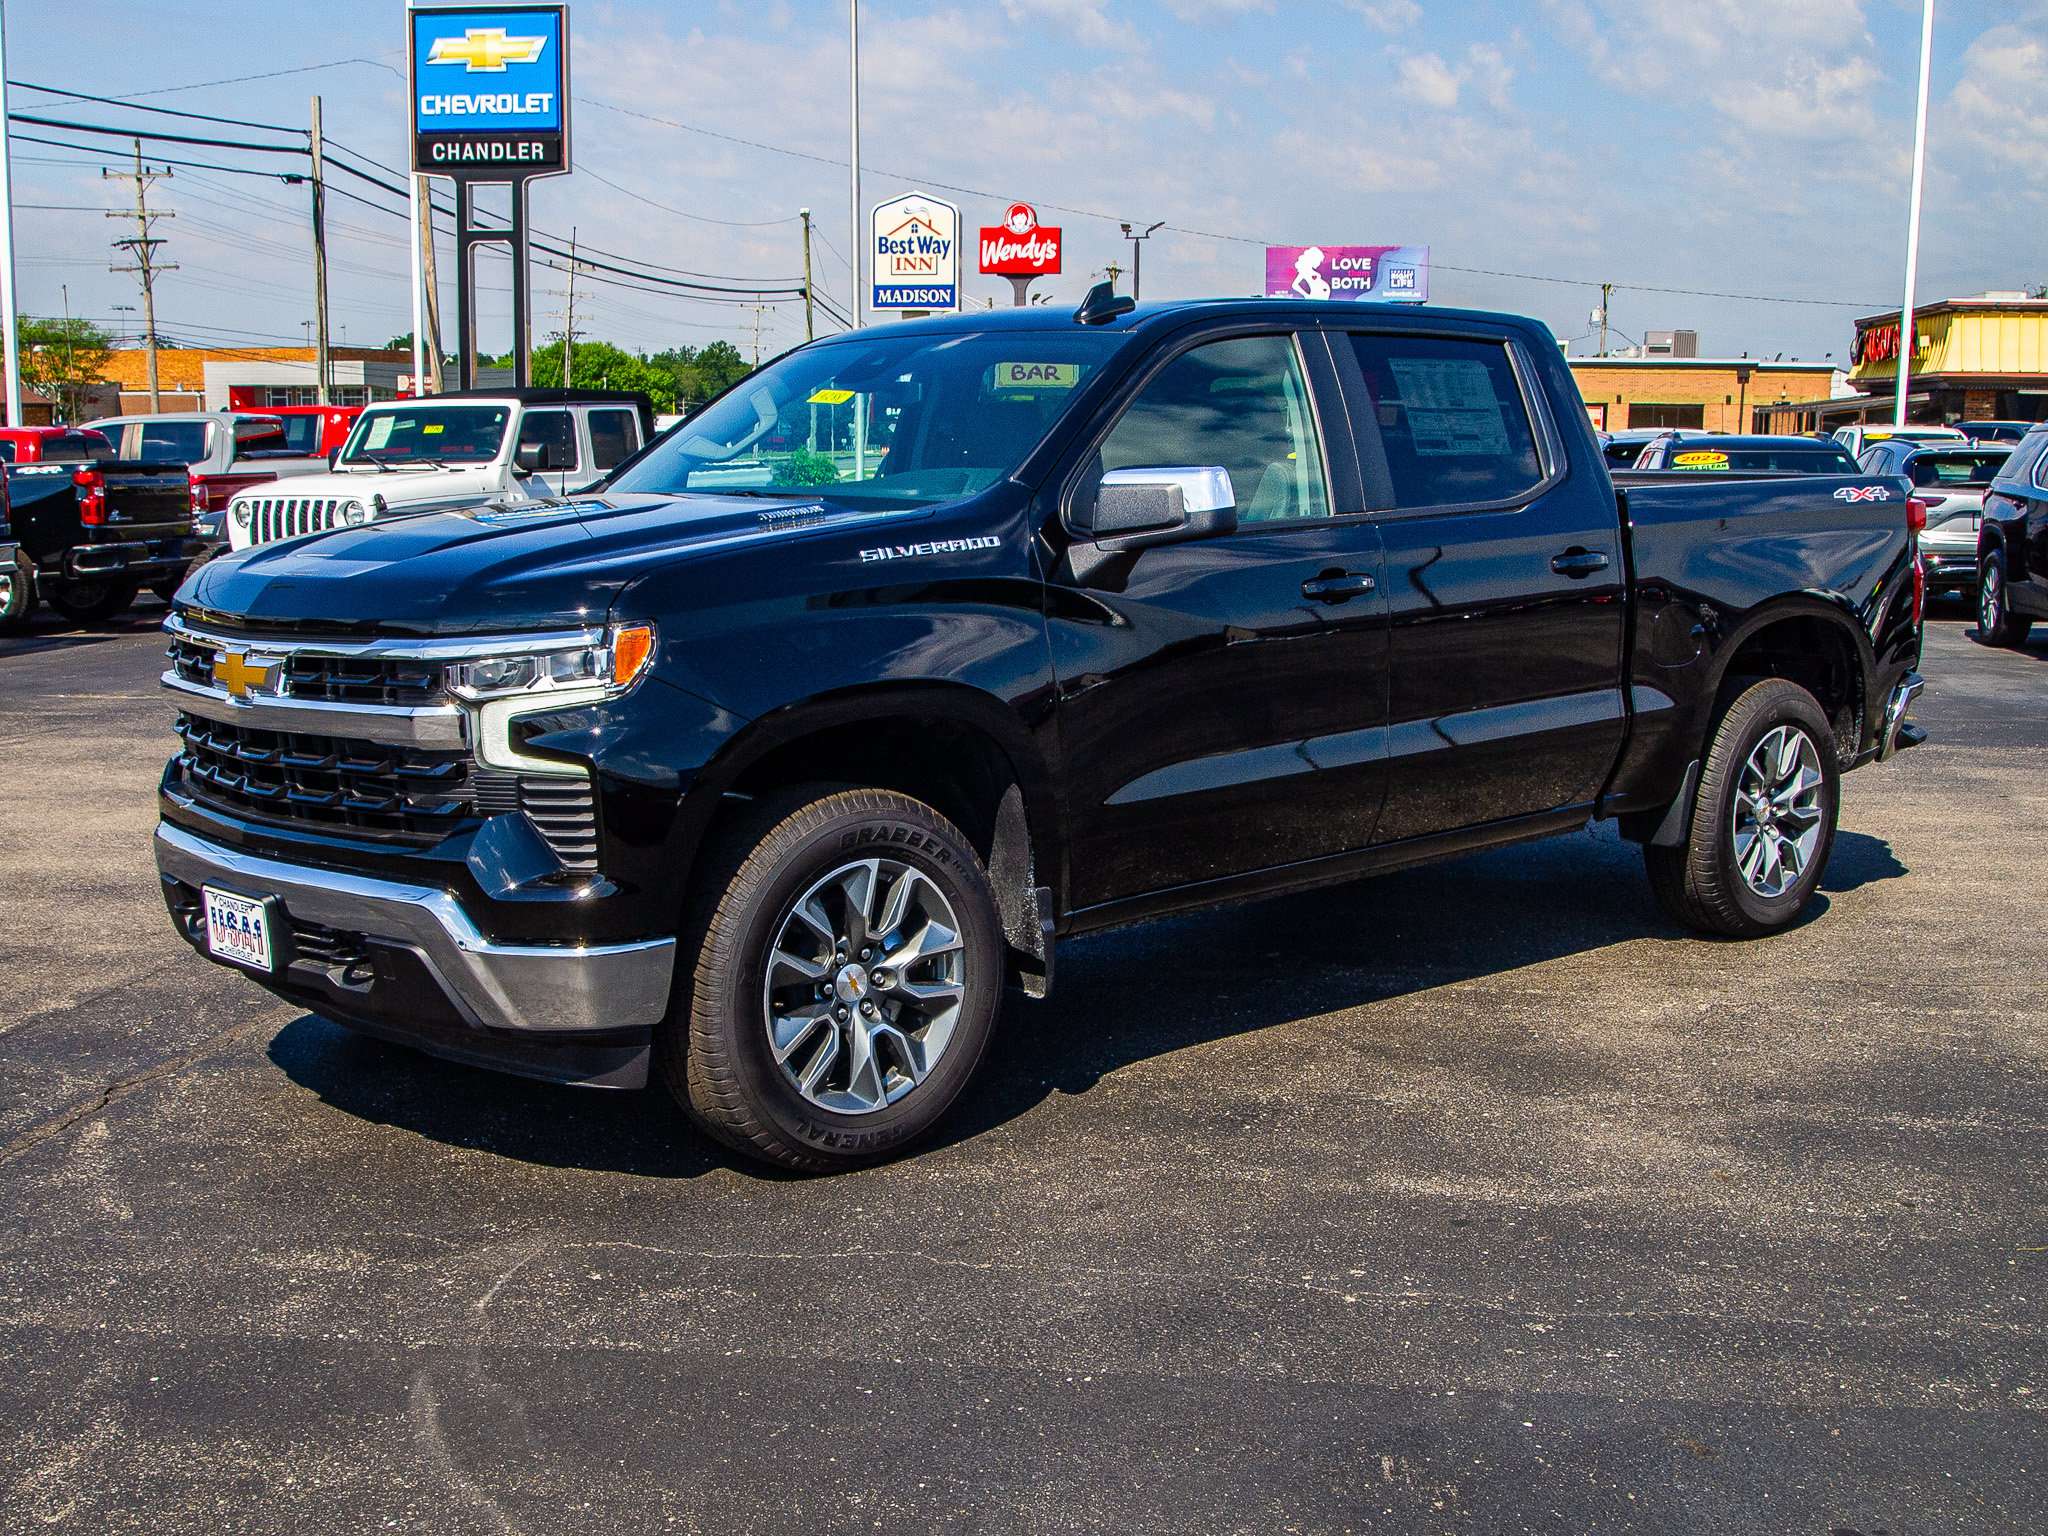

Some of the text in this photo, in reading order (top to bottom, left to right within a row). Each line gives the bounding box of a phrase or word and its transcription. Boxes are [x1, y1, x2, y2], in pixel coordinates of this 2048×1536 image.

[421, 93, 553, 115] CHEVROLET
[432, 142, 544, 161] CHANDLER
[878, 236, 951, 260] Best Way
[981, 233, 1057, 267] Wendy's
[895, 257, 933, 271] INN
[1331, 257, 1372, 270] LOVE
[1331, 277, 1371, 290] BOTH
[1390, 279, 1414, 288] LIFE
[877, 289, 951, 303] MADISON
[1011, 364, 1061, 381] BAR
[1680, 453, 1722, 462] 2024
[859, 535, 1001, 562] SILVERADO
[841, 825, 951, 862] GRABBER
[796, 1119, 910, 1149] GENERAL
